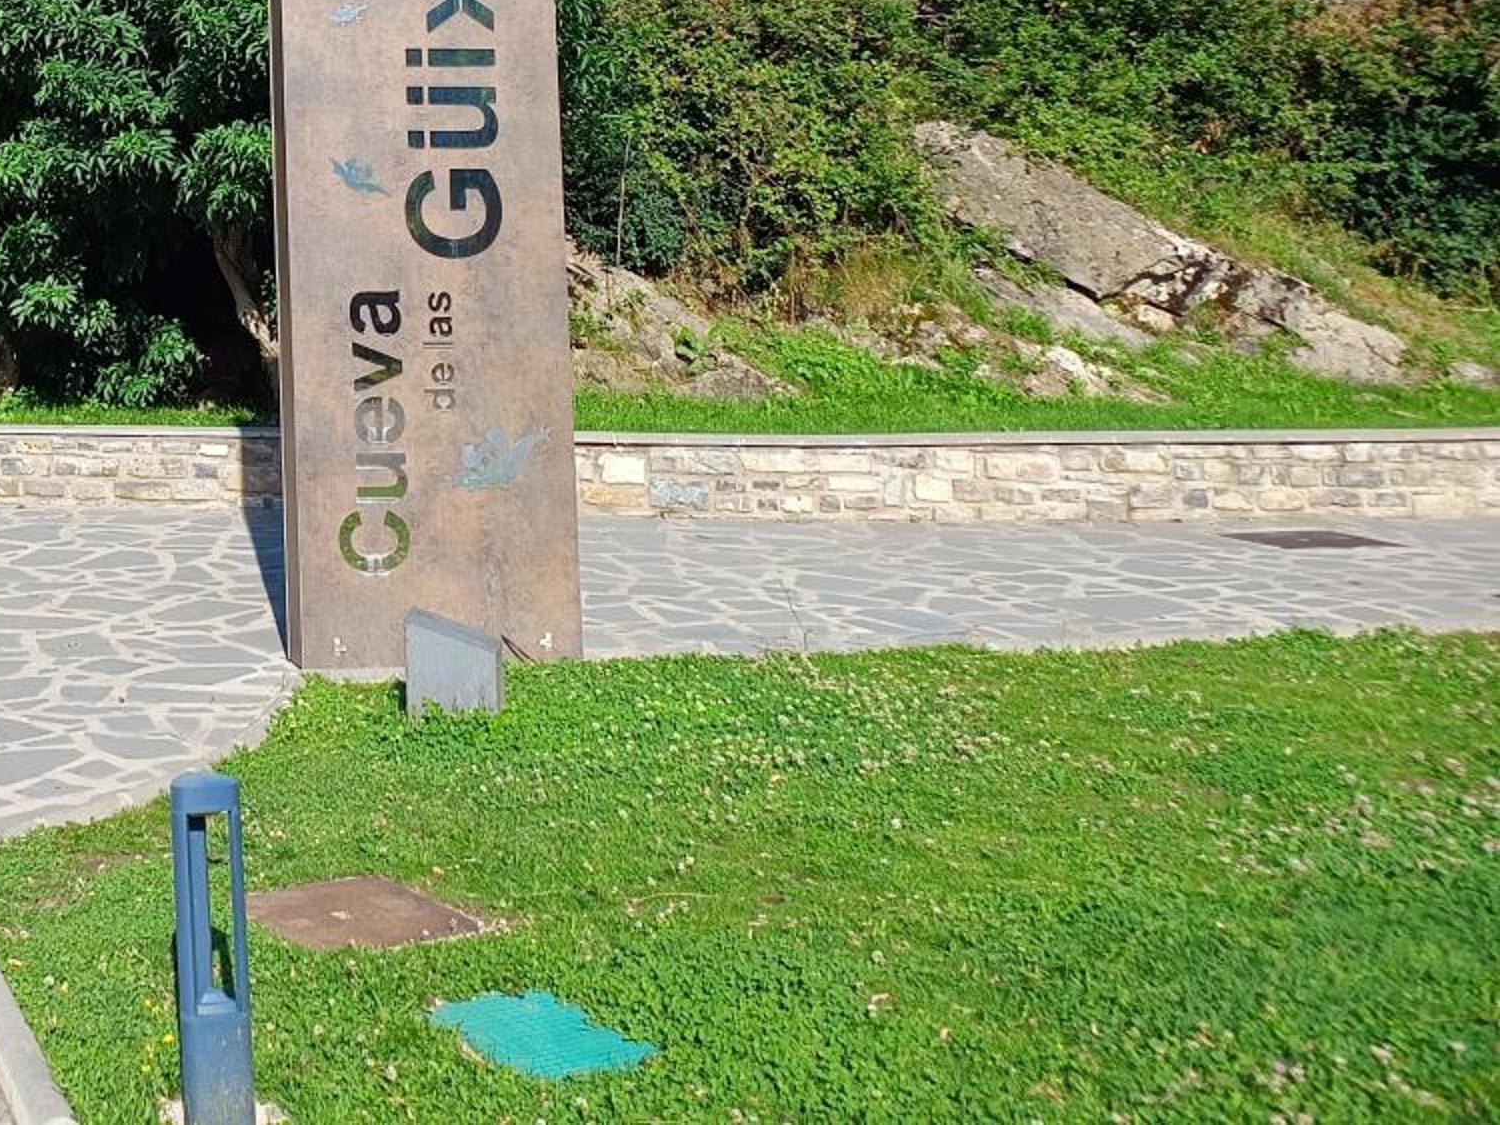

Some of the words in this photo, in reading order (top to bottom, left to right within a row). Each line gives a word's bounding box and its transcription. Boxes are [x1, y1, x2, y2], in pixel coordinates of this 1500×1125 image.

[422, 291, 454, 350] las
[423, 362, 455, 413] de
[339, 289, 411, 576] Cueva
